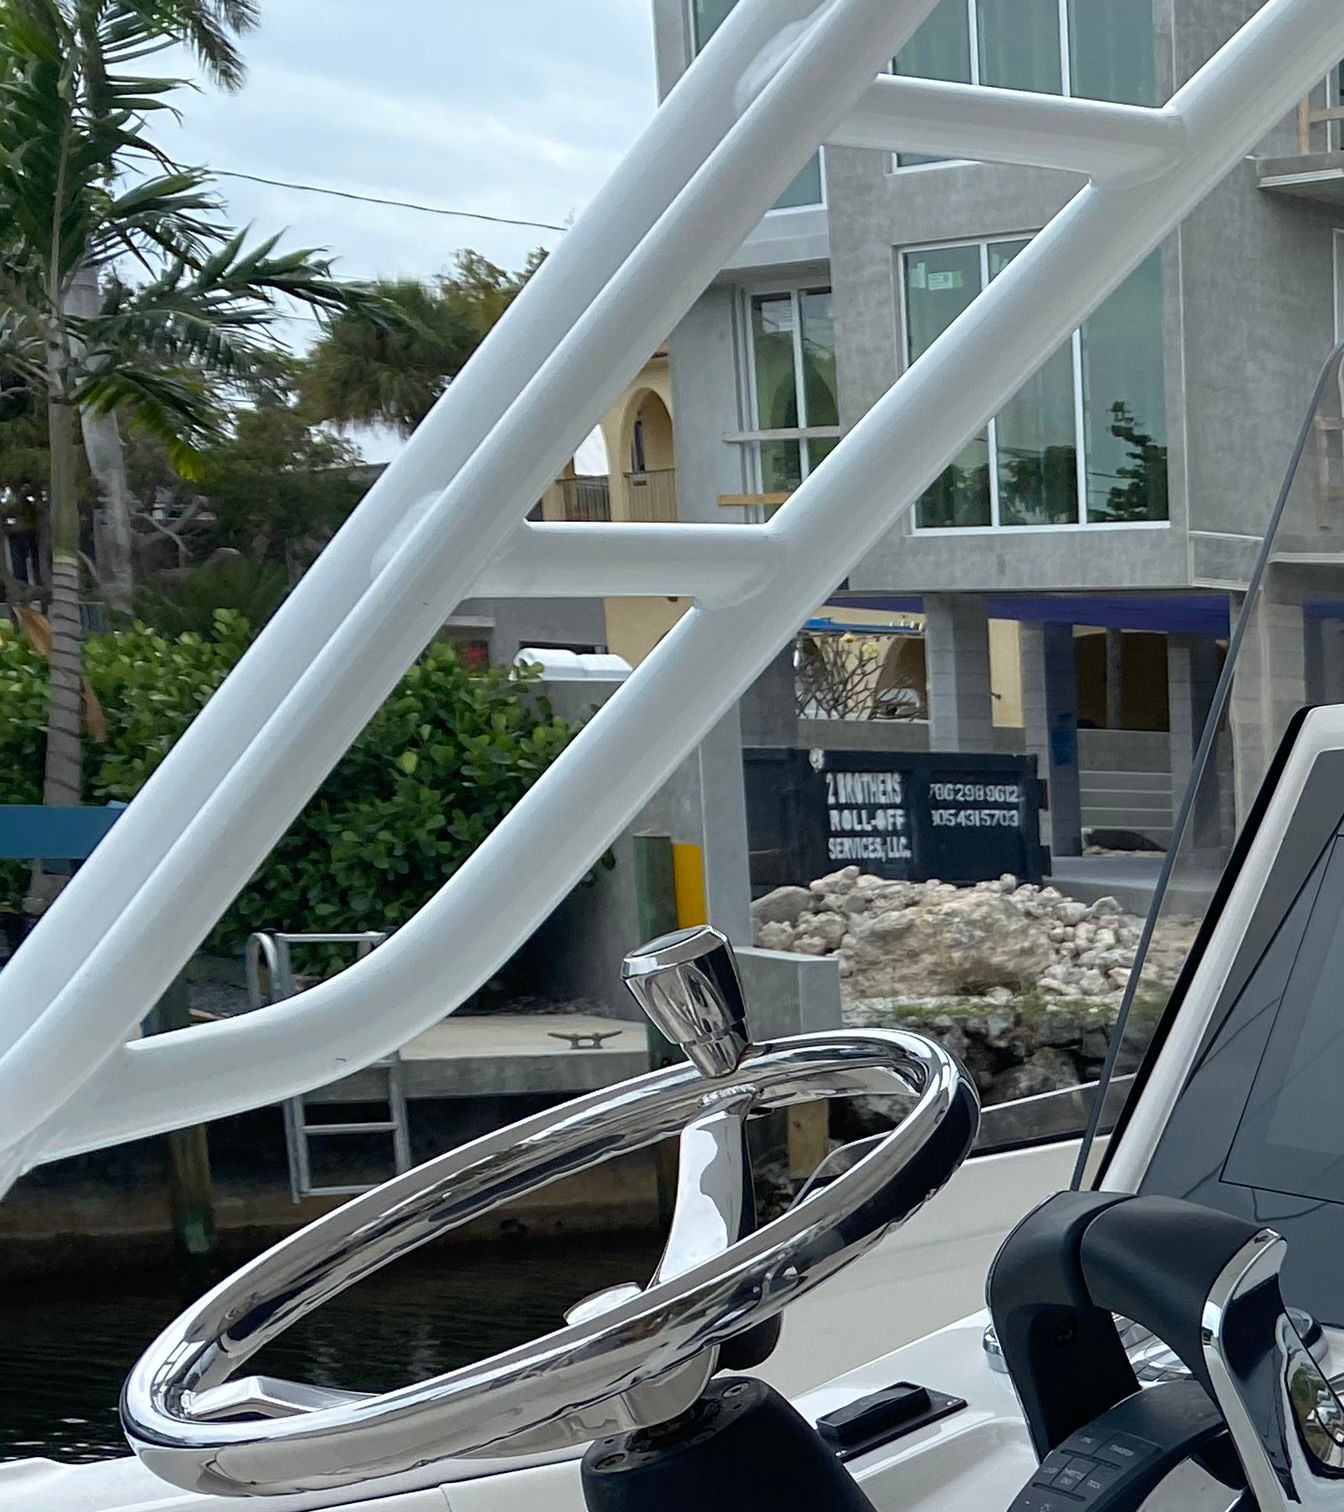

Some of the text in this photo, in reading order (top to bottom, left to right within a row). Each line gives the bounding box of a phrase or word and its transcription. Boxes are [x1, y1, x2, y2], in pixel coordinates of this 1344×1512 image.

[826, 772, 902, 805] 2 BROTHERS
[829, 809, 905, 831] ROLL-OFF
